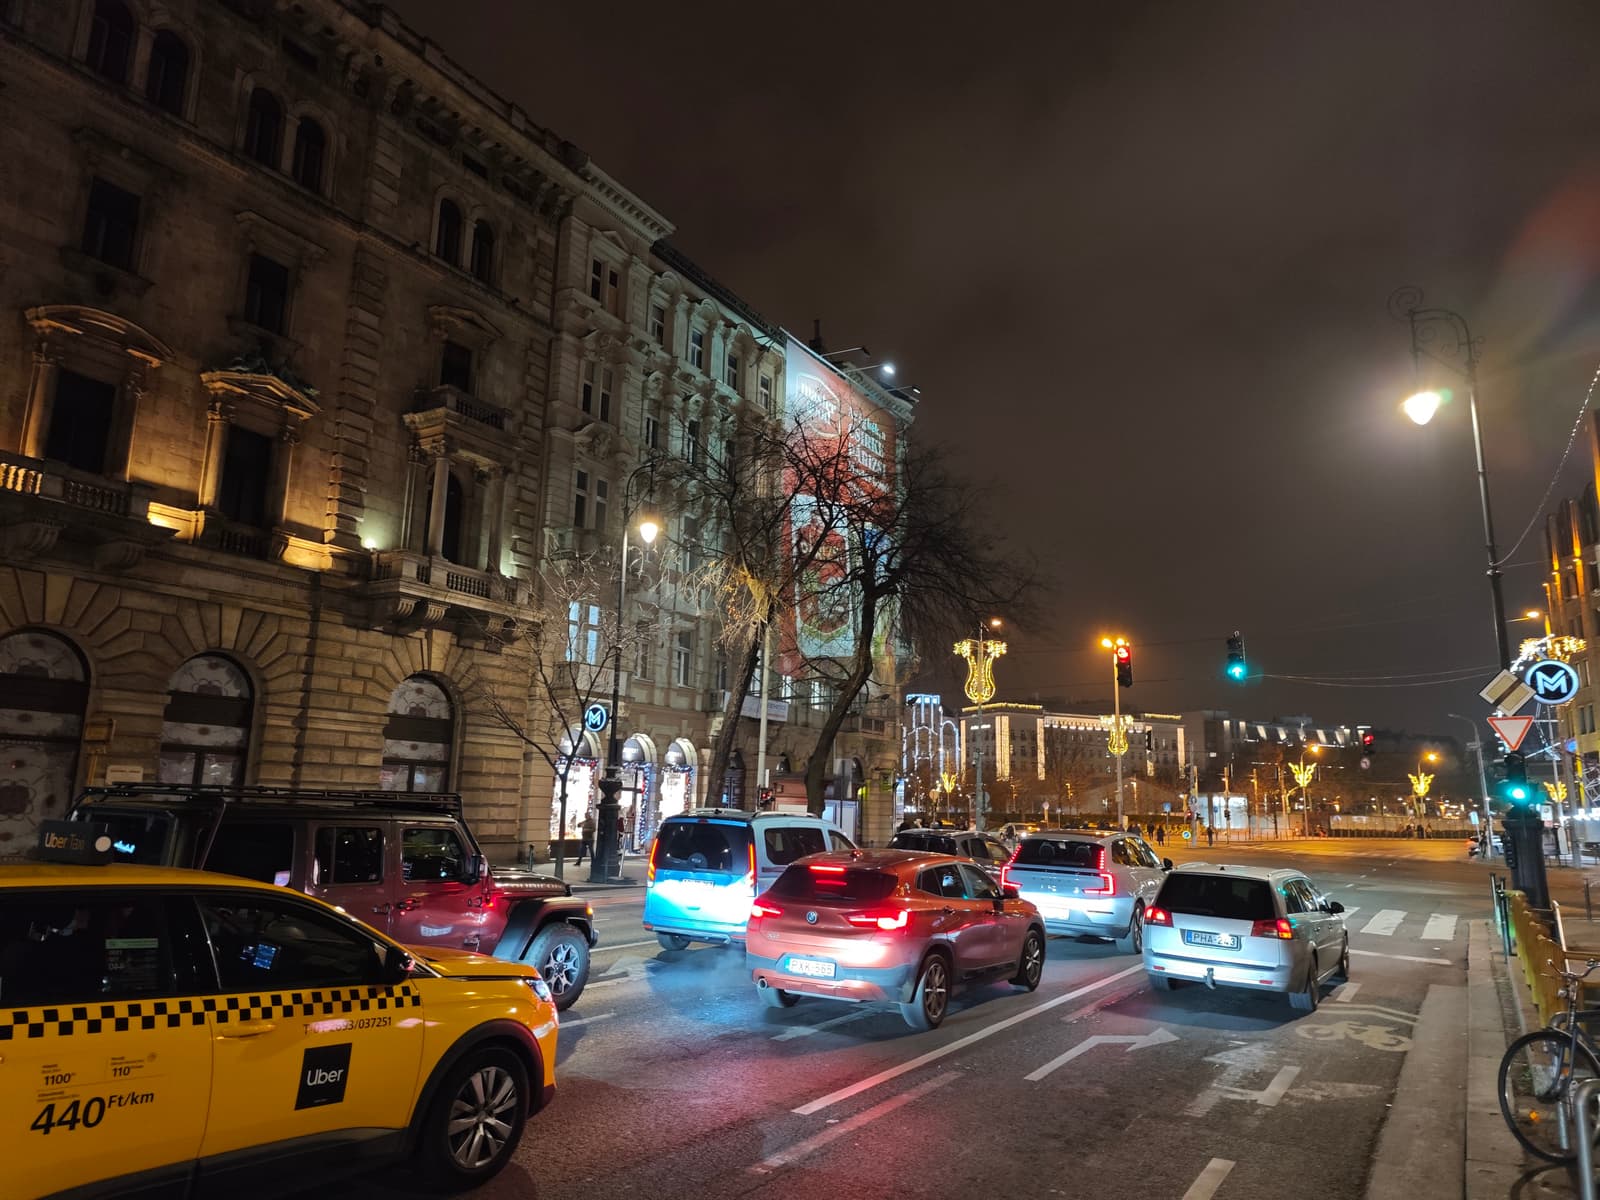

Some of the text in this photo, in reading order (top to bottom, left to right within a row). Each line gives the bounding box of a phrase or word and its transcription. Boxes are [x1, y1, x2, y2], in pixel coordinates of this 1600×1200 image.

[1535, 669, 1568, 695] M
[44, 831, 68, 849] Uber
[44, 1072, 72, 1086] 1100
[112, 1066, 131, 1078] 110
[306, 1068, 345, 1087] Uber
[30, 1091, 155, 1136] 440 Ft/km
